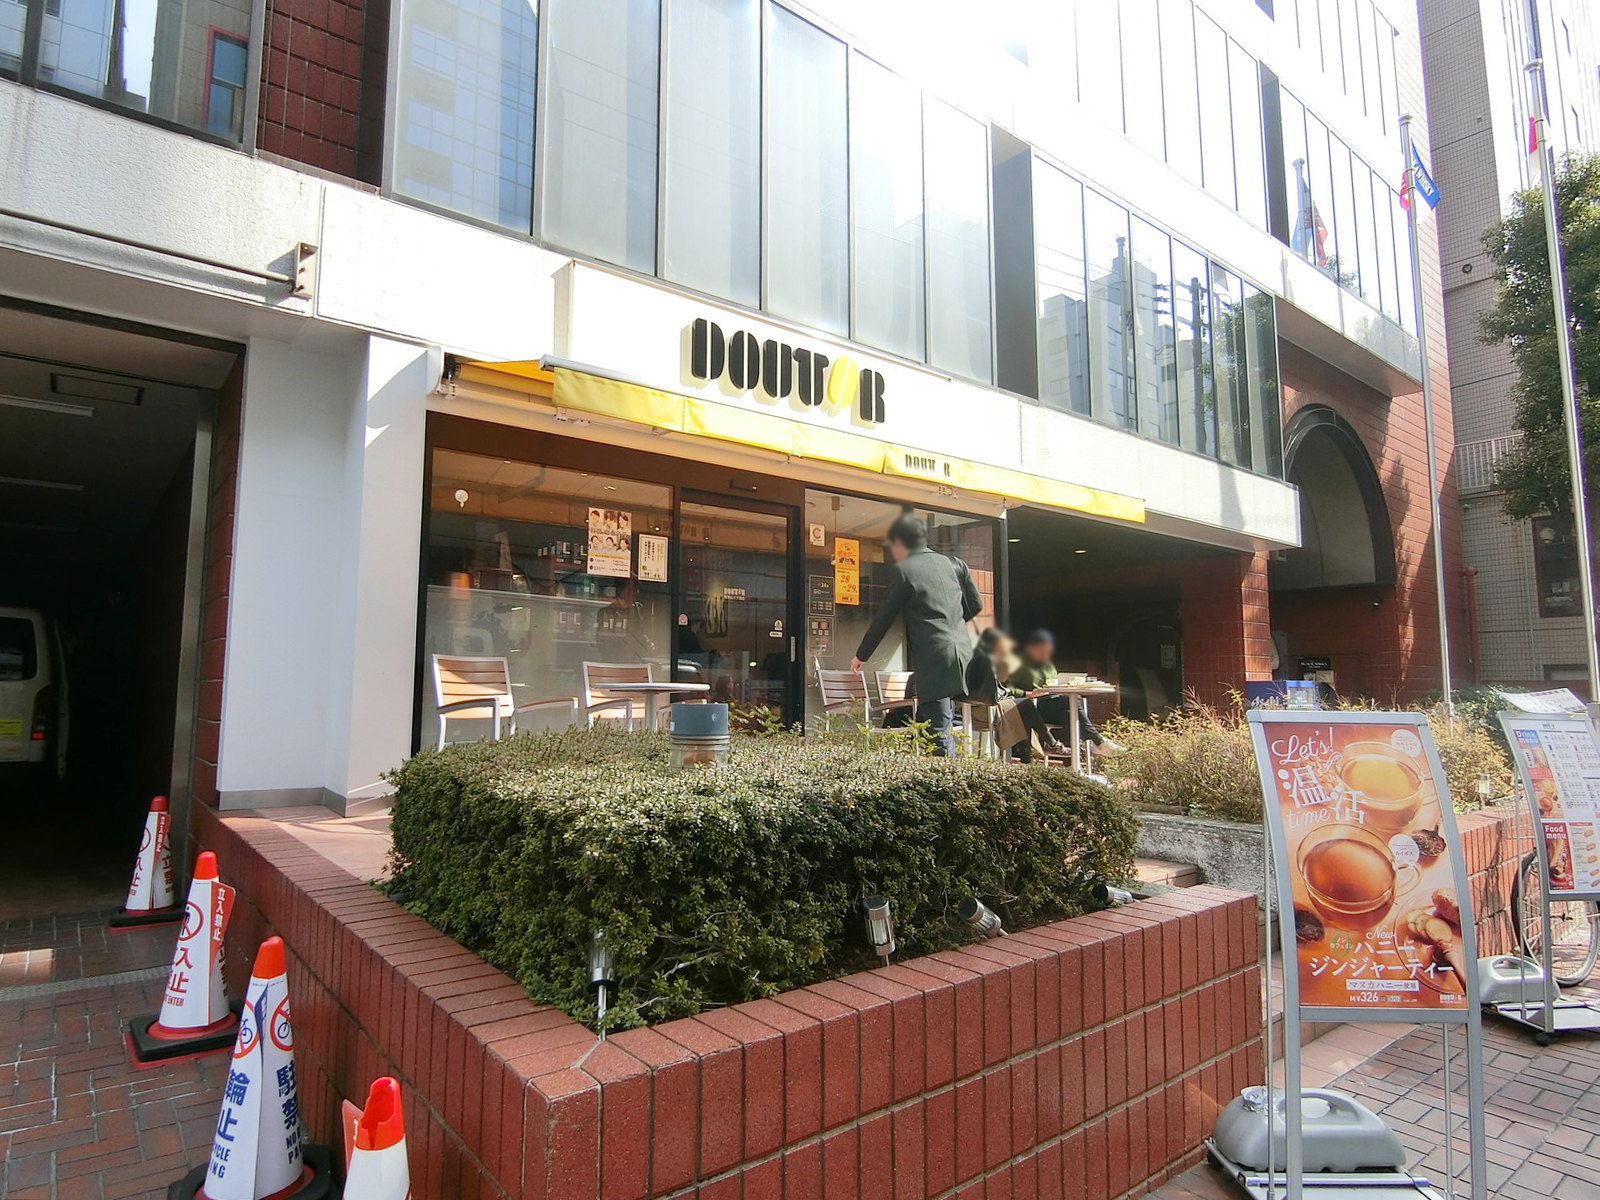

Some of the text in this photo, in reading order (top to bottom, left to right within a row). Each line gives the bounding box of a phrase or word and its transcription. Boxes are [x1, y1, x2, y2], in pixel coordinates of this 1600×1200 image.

[688, 317, 886, 424] DOUTOR
[905, 453, 950, 478] DOUTR
[1271, 726, 1334, 765] Let's!
[1287, 807, 1331, 829] time
[1544, 825, 1564, 833] Food
[212, 887, 227, 941] 立入禁止
[1365, 925, 1397, 940] New
[173, 947, 193, 970] 入
[1309, 955, 1455, 980] ジンジャーティー
[225, 1068, 251, 1107] 輪
[276, 1059, 298, 1098] 駐
[217, 1107, 239, 1142] 止
